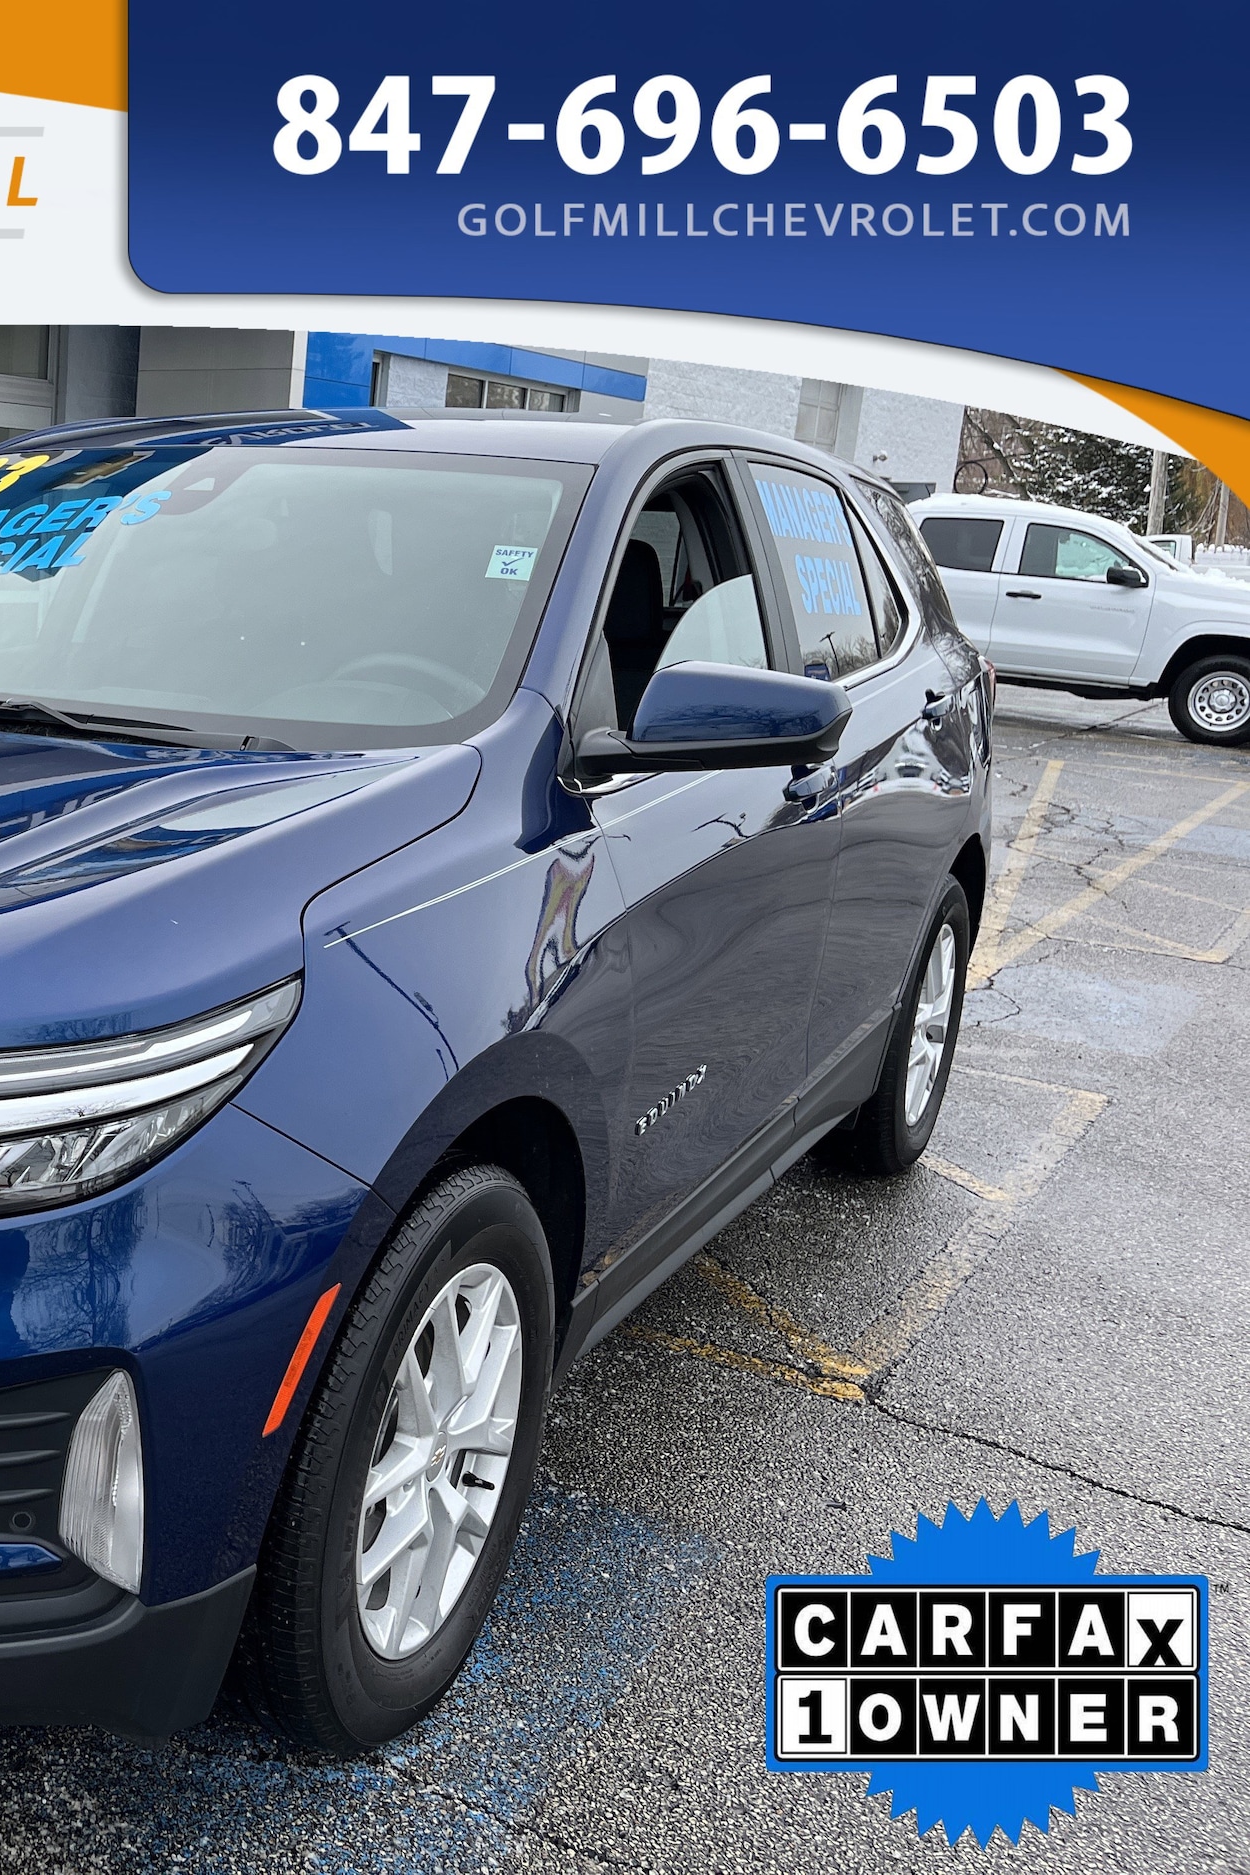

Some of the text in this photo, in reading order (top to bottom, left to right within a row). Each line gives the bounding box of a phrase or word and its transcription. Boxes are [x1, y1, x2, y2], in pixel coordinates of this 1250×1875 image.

[495, 548, 535, 558] SAFETY
[500, 567, 519, 576] OK
[794, 554, 862, 616] SPECIAL
